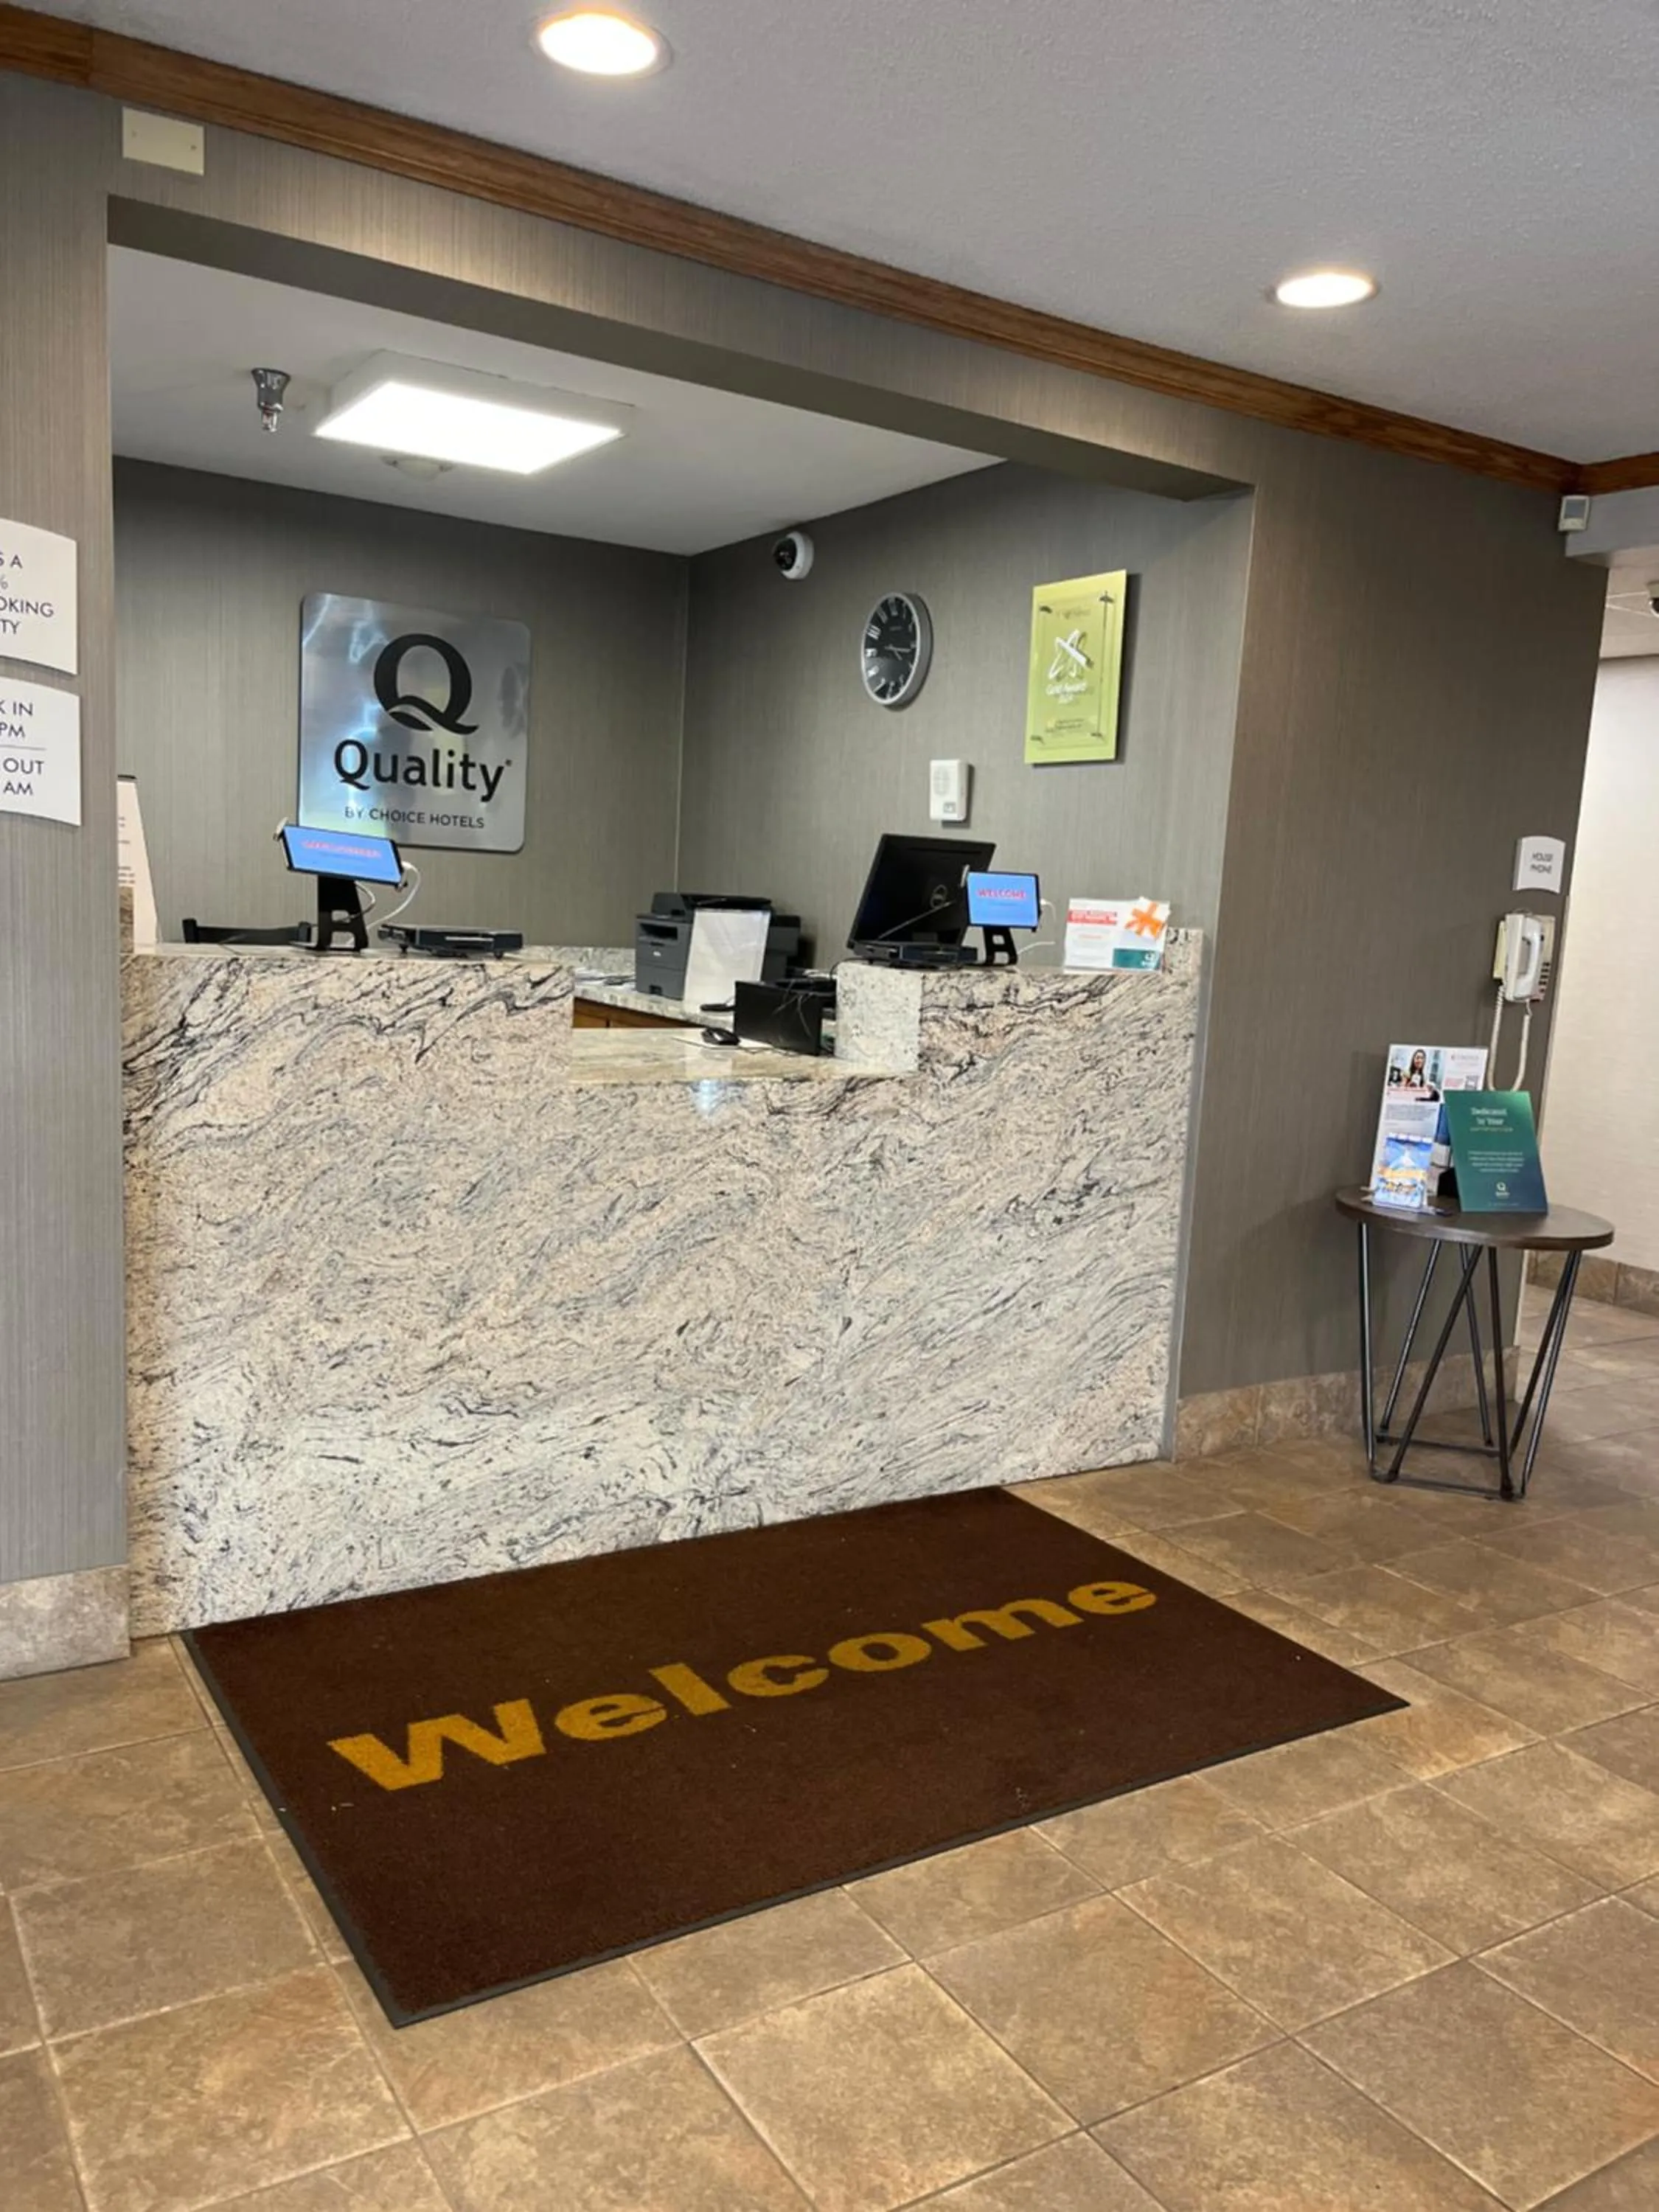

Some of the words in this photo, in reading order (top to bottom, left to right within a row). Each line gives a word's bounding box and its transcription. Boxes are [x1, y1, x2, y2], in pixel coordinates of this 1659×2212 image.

[10, 554, 23, 568] A
[13, 701, 33, 716] IN
[3, 757, 45, 775] OUT
[334, 738, 505, 803] Quality
[3, 781, 33, 796] AM
[344, 806, 364, 818] BY
[369, 807, 426, 824] CHOICE
[429, 813, 485, 829] HOTELS
[326, 1580, 1158, 1792] Welcome
